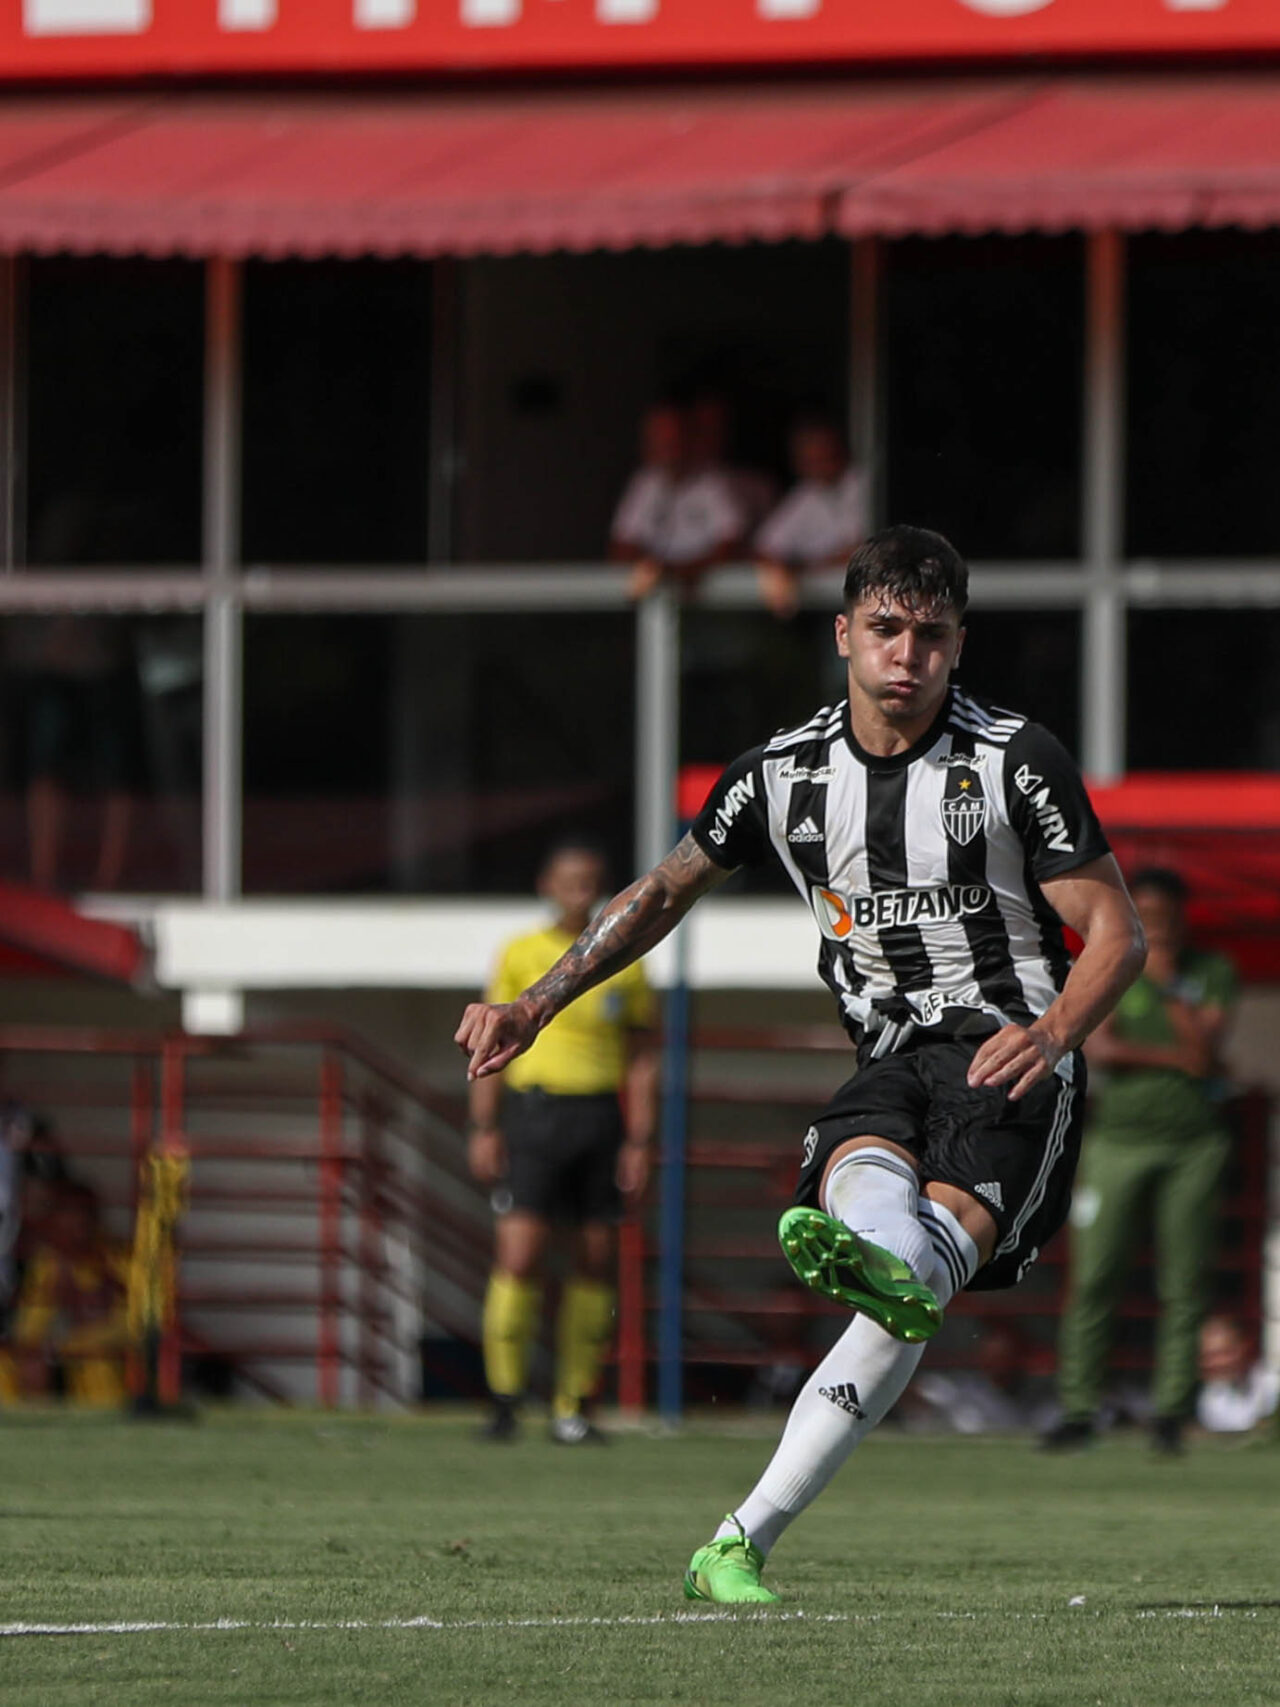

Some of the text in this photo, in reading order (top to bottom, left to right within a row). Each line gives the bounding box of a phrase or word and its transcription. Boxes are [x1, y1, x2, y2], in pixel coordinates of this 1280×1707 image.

[716, 771, 756, 827] MRV
[948, 801, 982, 812] CAM
[788, 832, 825, 844] adidas
[1031, 788, 1074, 853] MRV
[853, 886, 991, 928] BETANO
[818, 1386, 866, 1420] adidas
